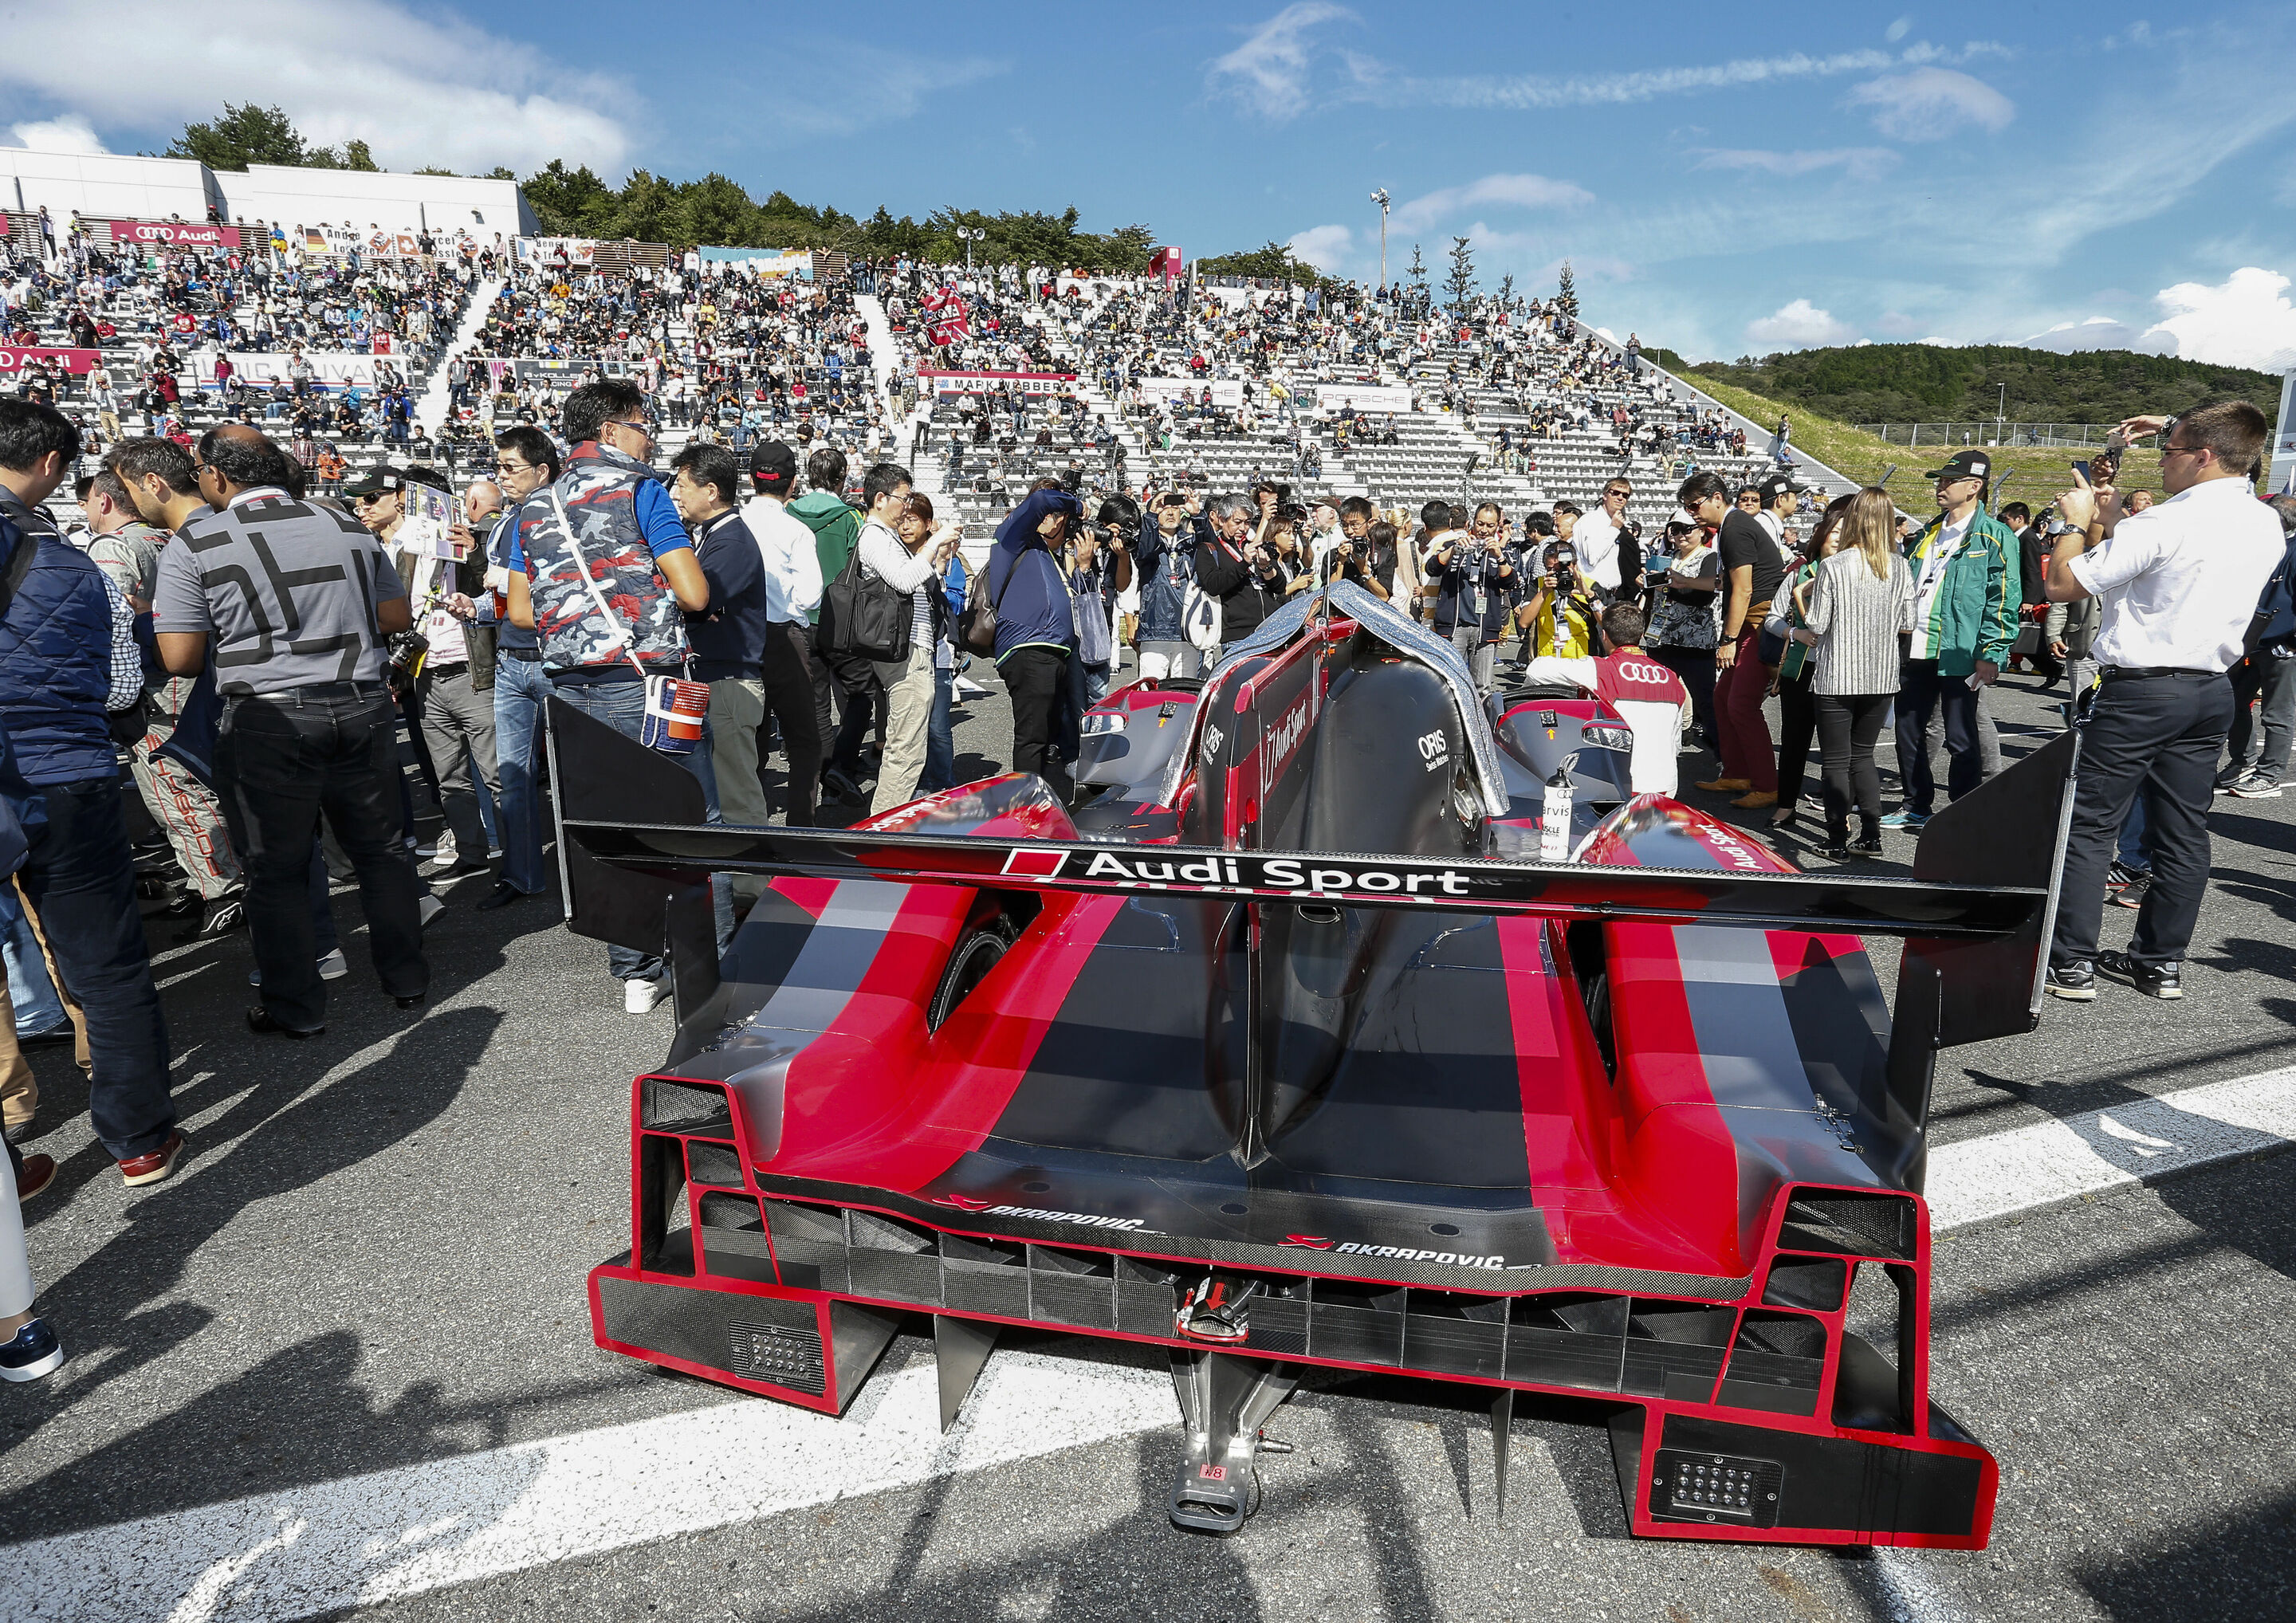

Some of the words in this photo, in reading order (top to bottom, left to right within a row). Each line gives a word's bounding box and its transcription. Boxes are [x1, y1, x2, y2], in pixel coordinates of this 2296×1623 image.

[178, 229, 216, 242] Audi
[954, 379, 995, 390] MARK
[1322, 393, 1406, 404] PORSCHE
[1275, 726, 1291, 768] Audi
[1291, 698, 1307, 749] Sport
[1418, 729, 1447, 760] ORIS
[1425, 760, 1437, 772] Swiss
[1695, 823, 1738, 846] Sport
[1717, 846, 1763, 870] Audi
[1084, 853, 1240, 883] Audi
[1264, 859, 1469, 895] Sport
